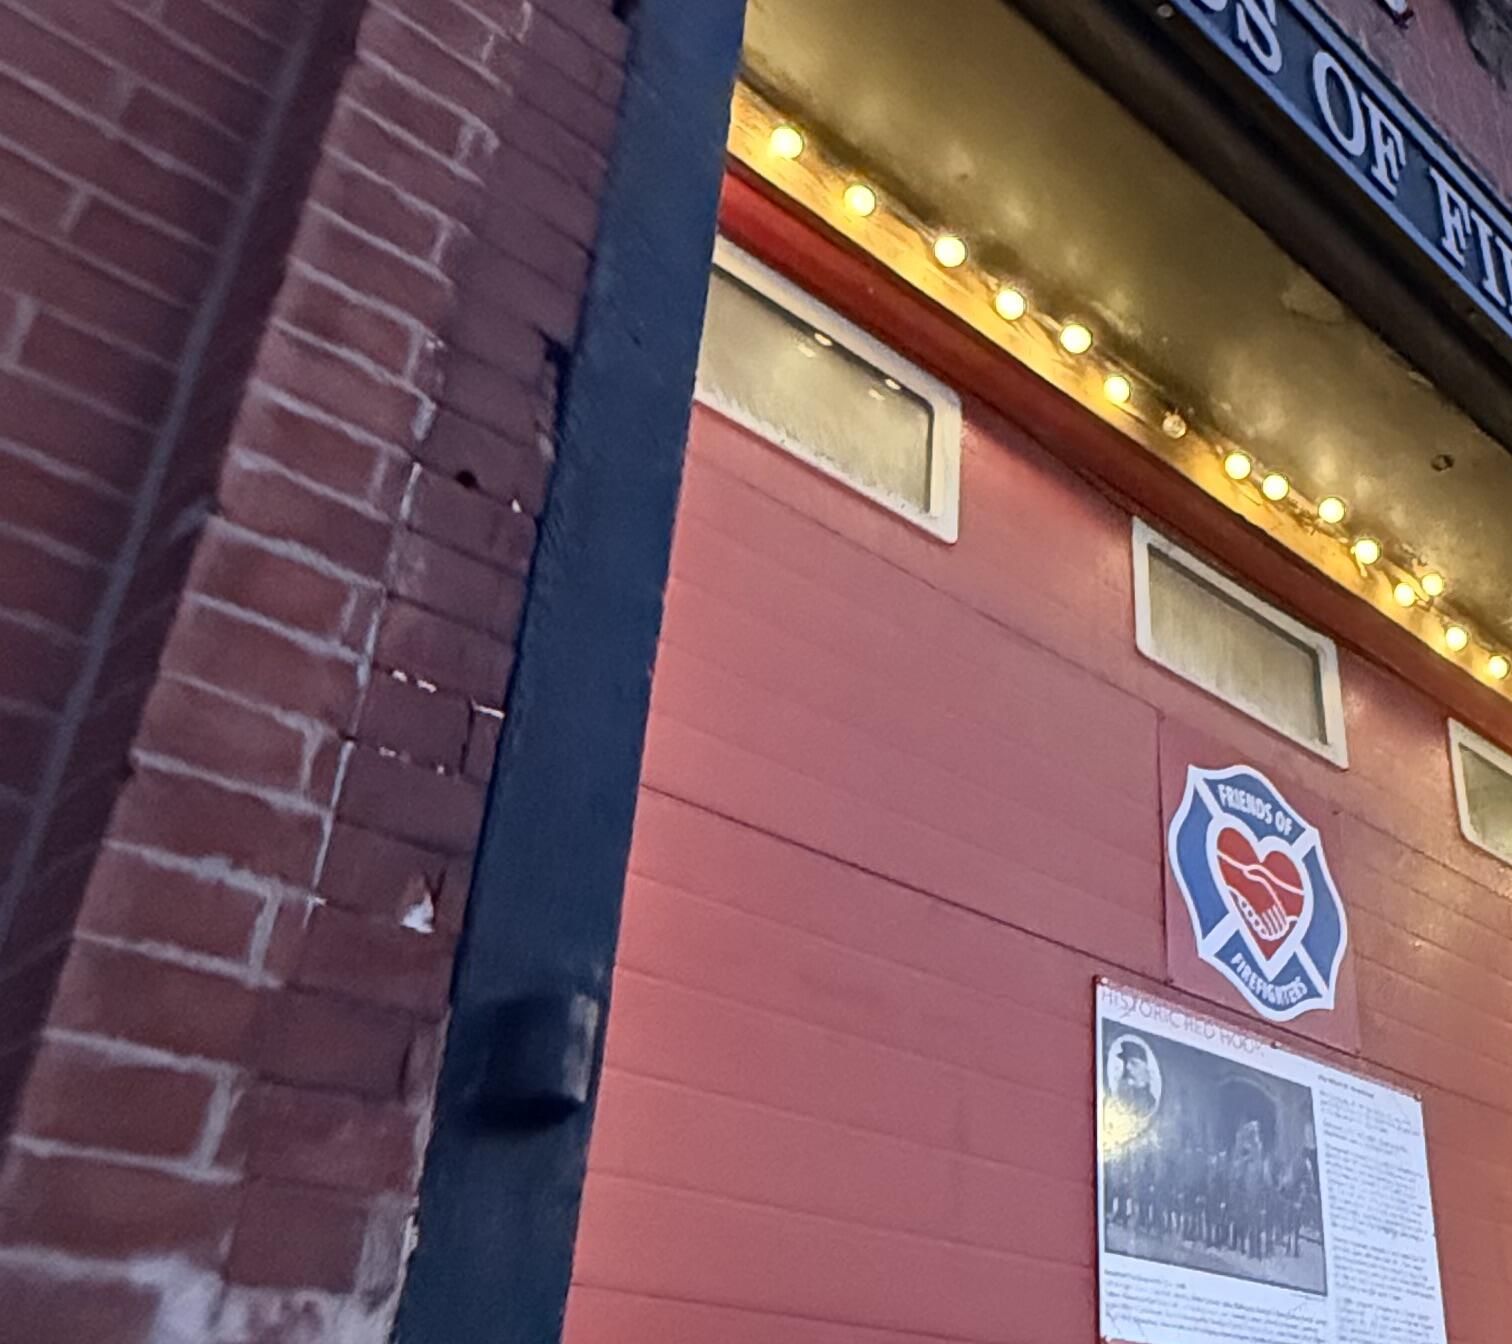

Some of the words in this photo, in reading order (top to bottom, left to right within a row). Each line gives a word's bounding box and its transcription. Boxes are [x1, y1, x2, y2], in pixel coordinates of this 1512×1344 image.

[1312, 51, 1406, 196] OF
[1217, 784, 1273, 825] FRIENDS
[1275, 810, 1293, 836] OF
[1230, 952, 1308, 1005] FIREFIGHTERS
